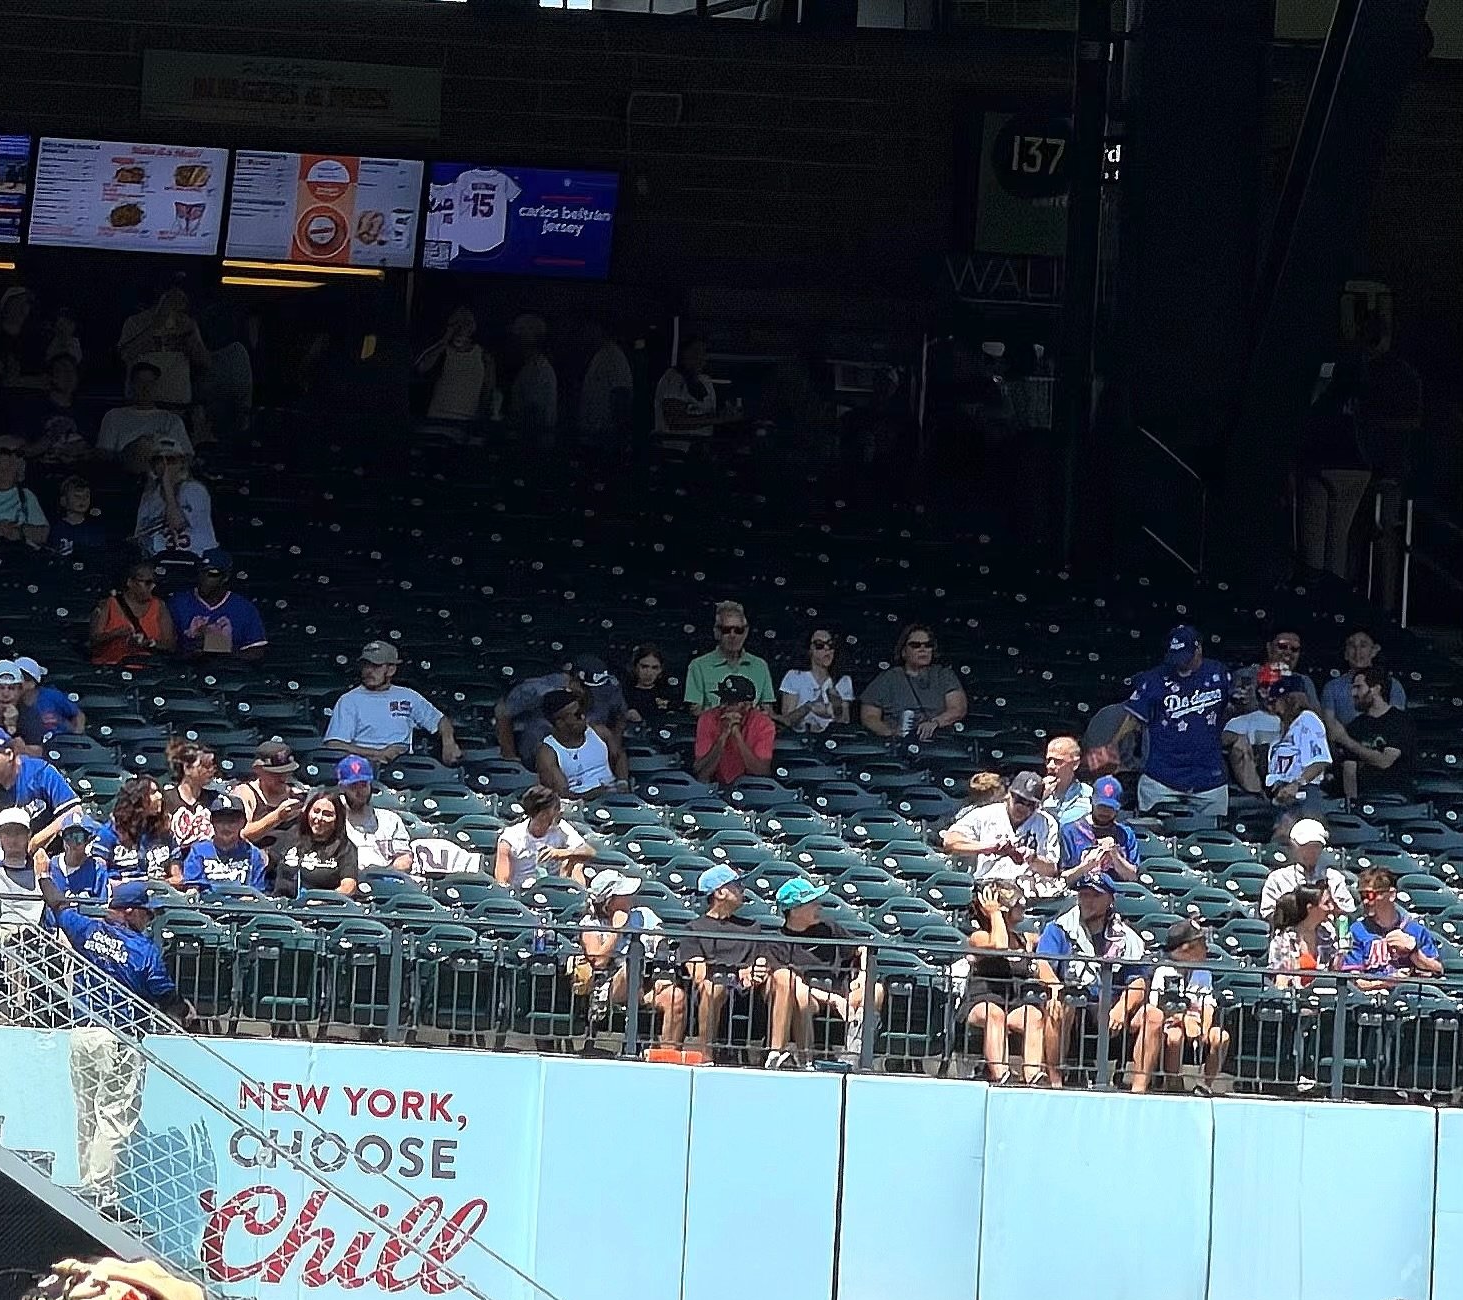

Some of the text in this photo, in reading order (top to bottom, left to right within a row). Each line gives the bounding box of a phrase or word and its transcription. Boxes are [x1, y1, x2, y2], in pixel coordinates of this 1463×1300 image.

[1010, 135, 1066, 175] 137
[470, 192, 494, 218] 15
[518, 207, 559, 222] carlos
[540, 221, 584, 238] jersey
[1164, 688, 1223, 719] Dodgers
[239, 1082, 468, 1130] NEW YORK,
[229, 1127, 458, 1180] CHOOSE
[201, 1186, 487, 1295] Chill
